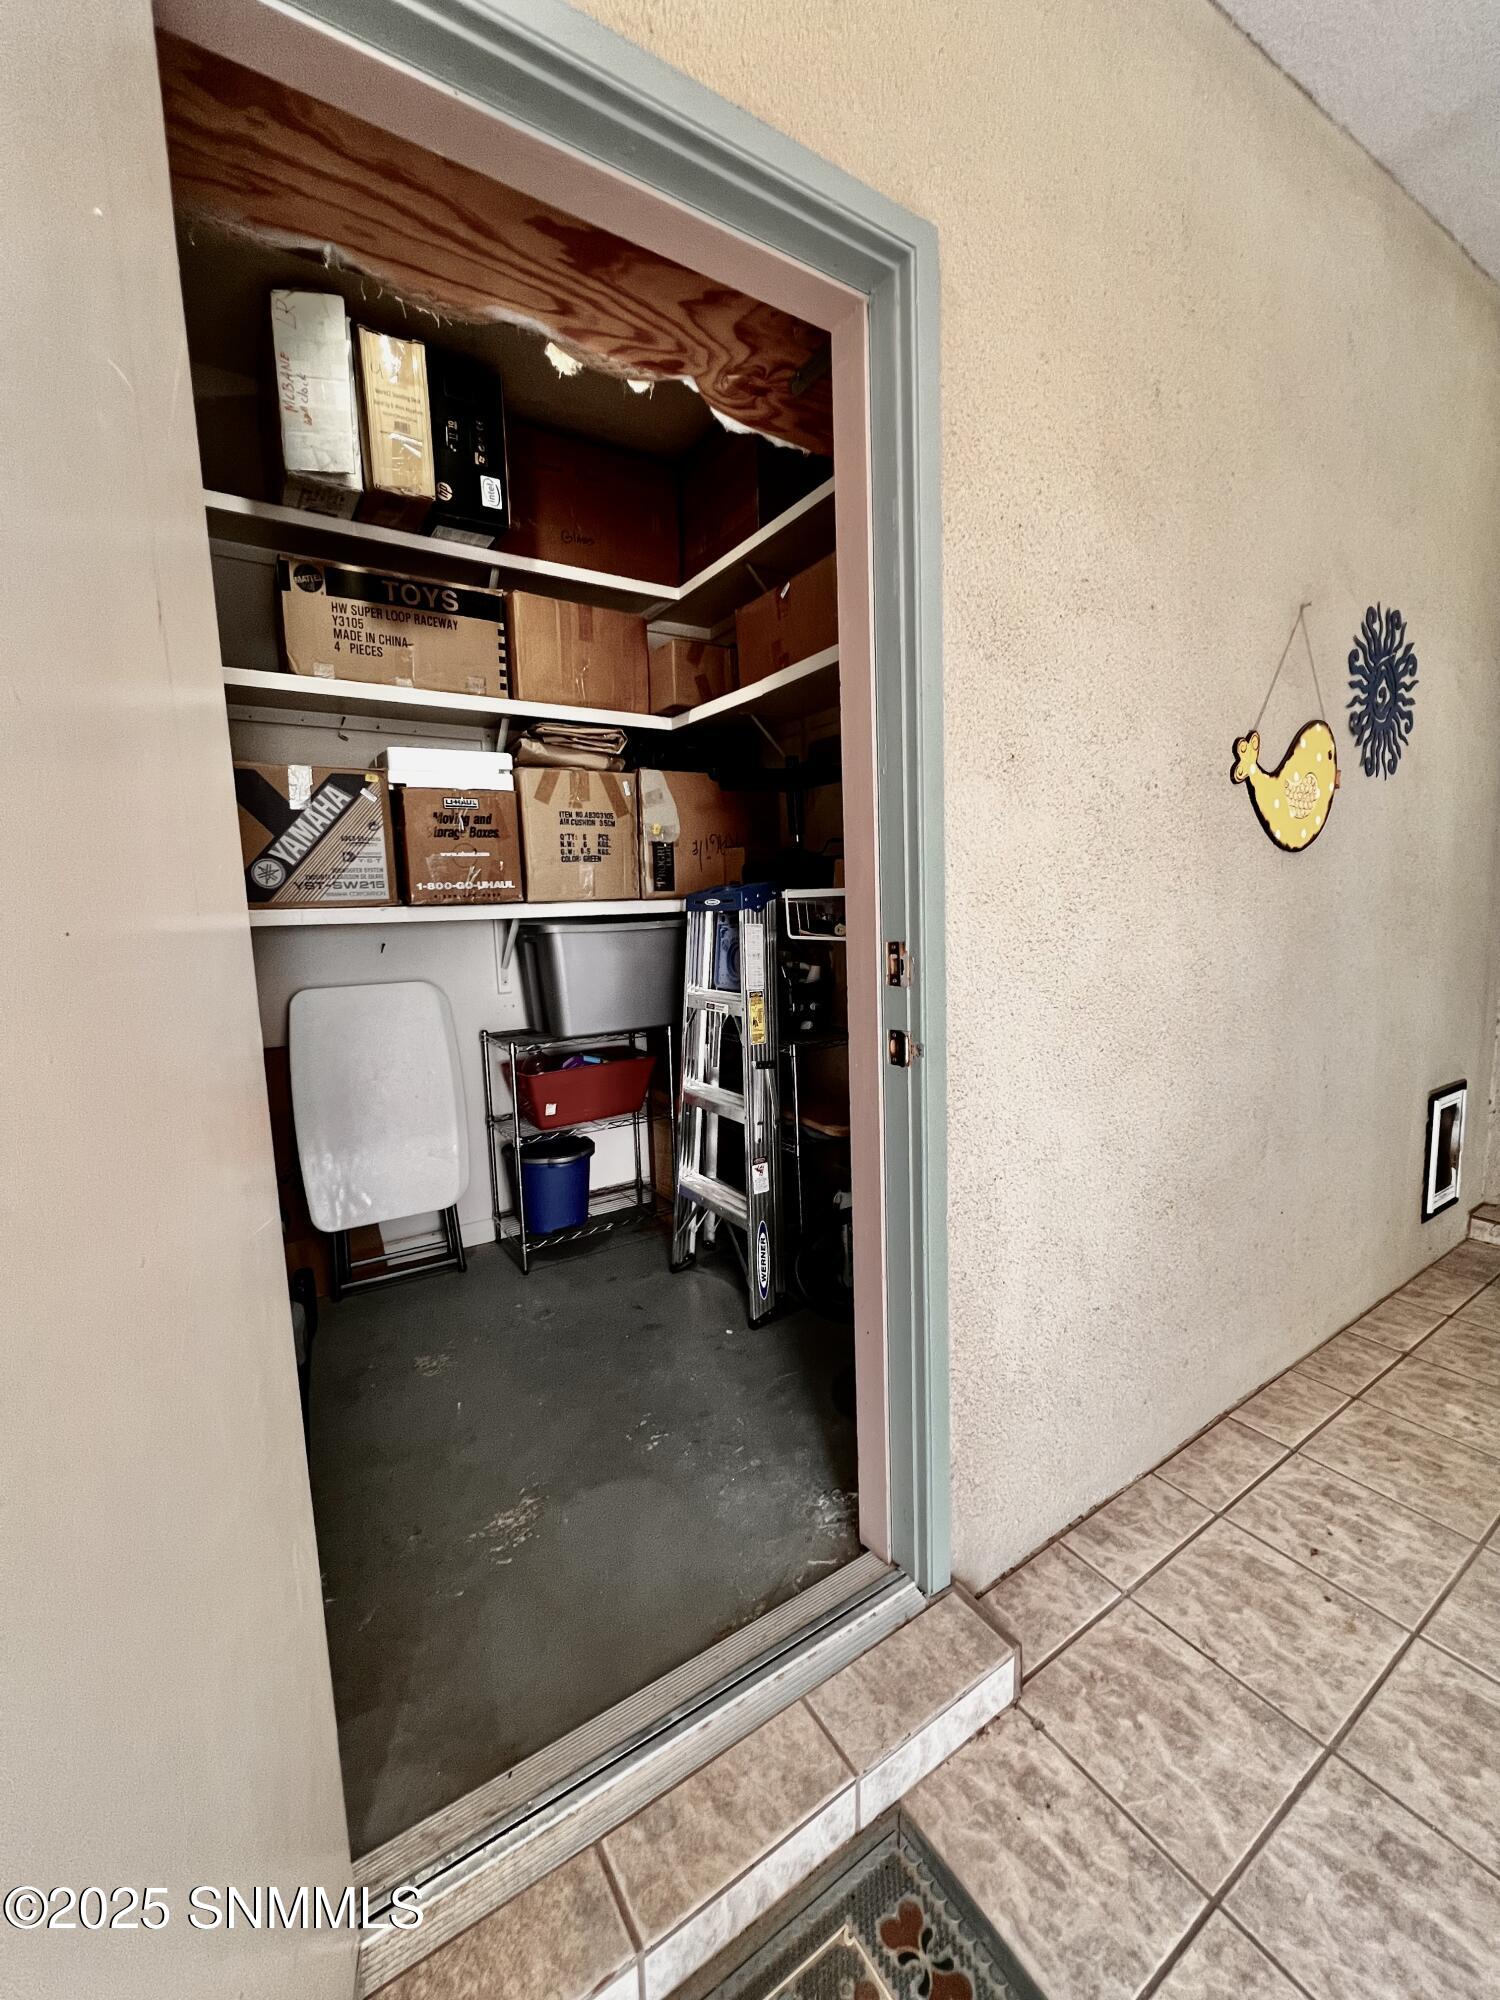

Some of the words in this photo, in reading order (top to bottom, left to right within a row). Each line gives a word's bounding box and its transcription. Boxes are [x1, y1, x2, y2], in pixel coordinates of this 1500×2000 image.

[294, 574, 322, 584] MATTEL
[382, 580, 459, 612] TOYS
[331, 602, 348, 614] HW
[351, 604, 383, 620] SUPER
[385, 610, 411, 623] LOOP
[414, 613, 458, 631] RACEWAY
[332, 615, 364, 629] Y3105
[333, 628, 362, 642] MADE
[365, 632, 376, 644] IN
[378, 634, 408, 648] CHINA
[334, 641, 341, 652] 4
[350, 643, 383, 657] PIECES
[267, 785, 354, 866] YAMAHA
[473, 813, 492, 825] and
[427, 827, 466, 840] torage
[469, 827, 500, 838] Boxes
